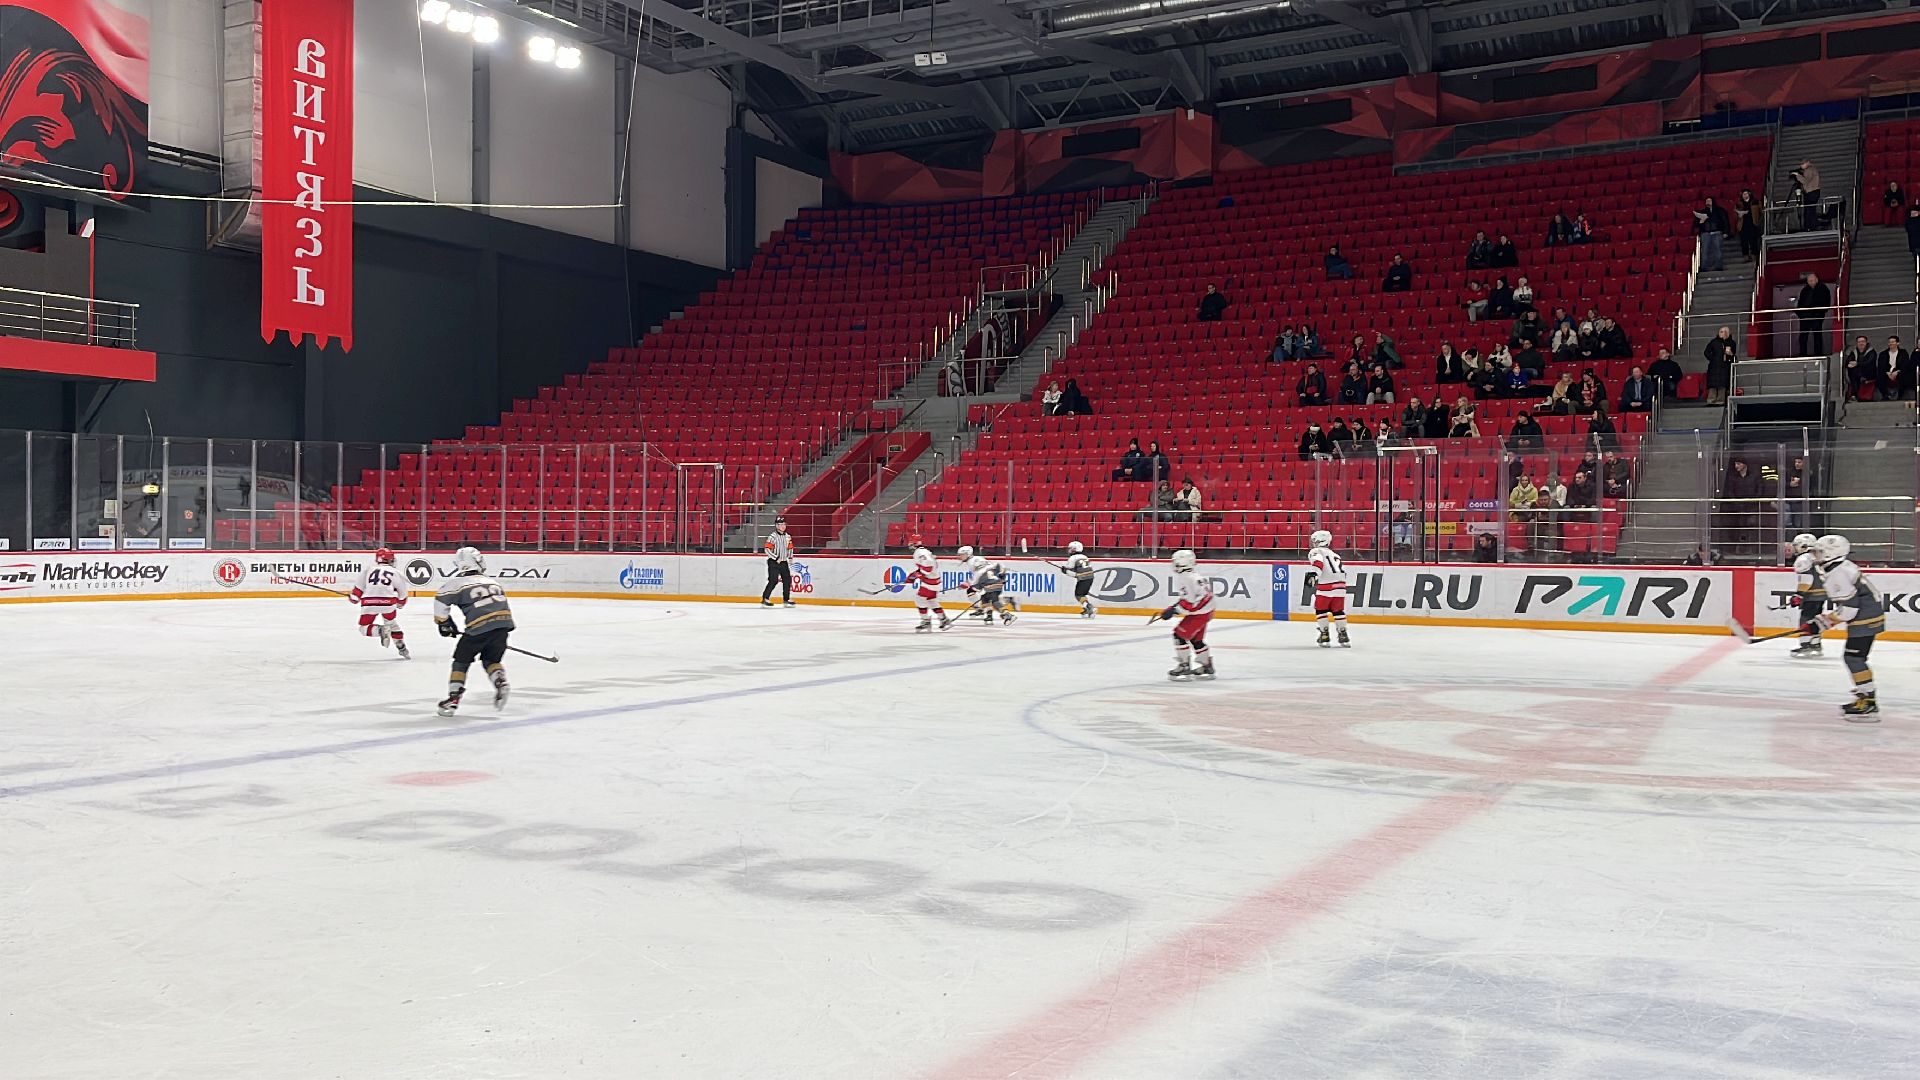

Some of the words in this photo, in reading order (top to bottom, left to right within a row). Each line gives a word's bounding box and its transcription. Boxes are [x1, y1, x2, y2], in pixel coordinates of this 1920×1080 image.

[292, 38, 326, 307] ВИТЯЗЬ
[309, 561, 361, 573] ОНЛАЙН
[437, 567, 552, 579] VDAI
[634, 568, 664, 578] ГАЗПРОМ
[368, 568, 394, 586] 45
[87, 581, 145, 589] YOURSELF
[1168, 576, 1251, 599] LDA
[1514, 575, 1711, 619] PARI
